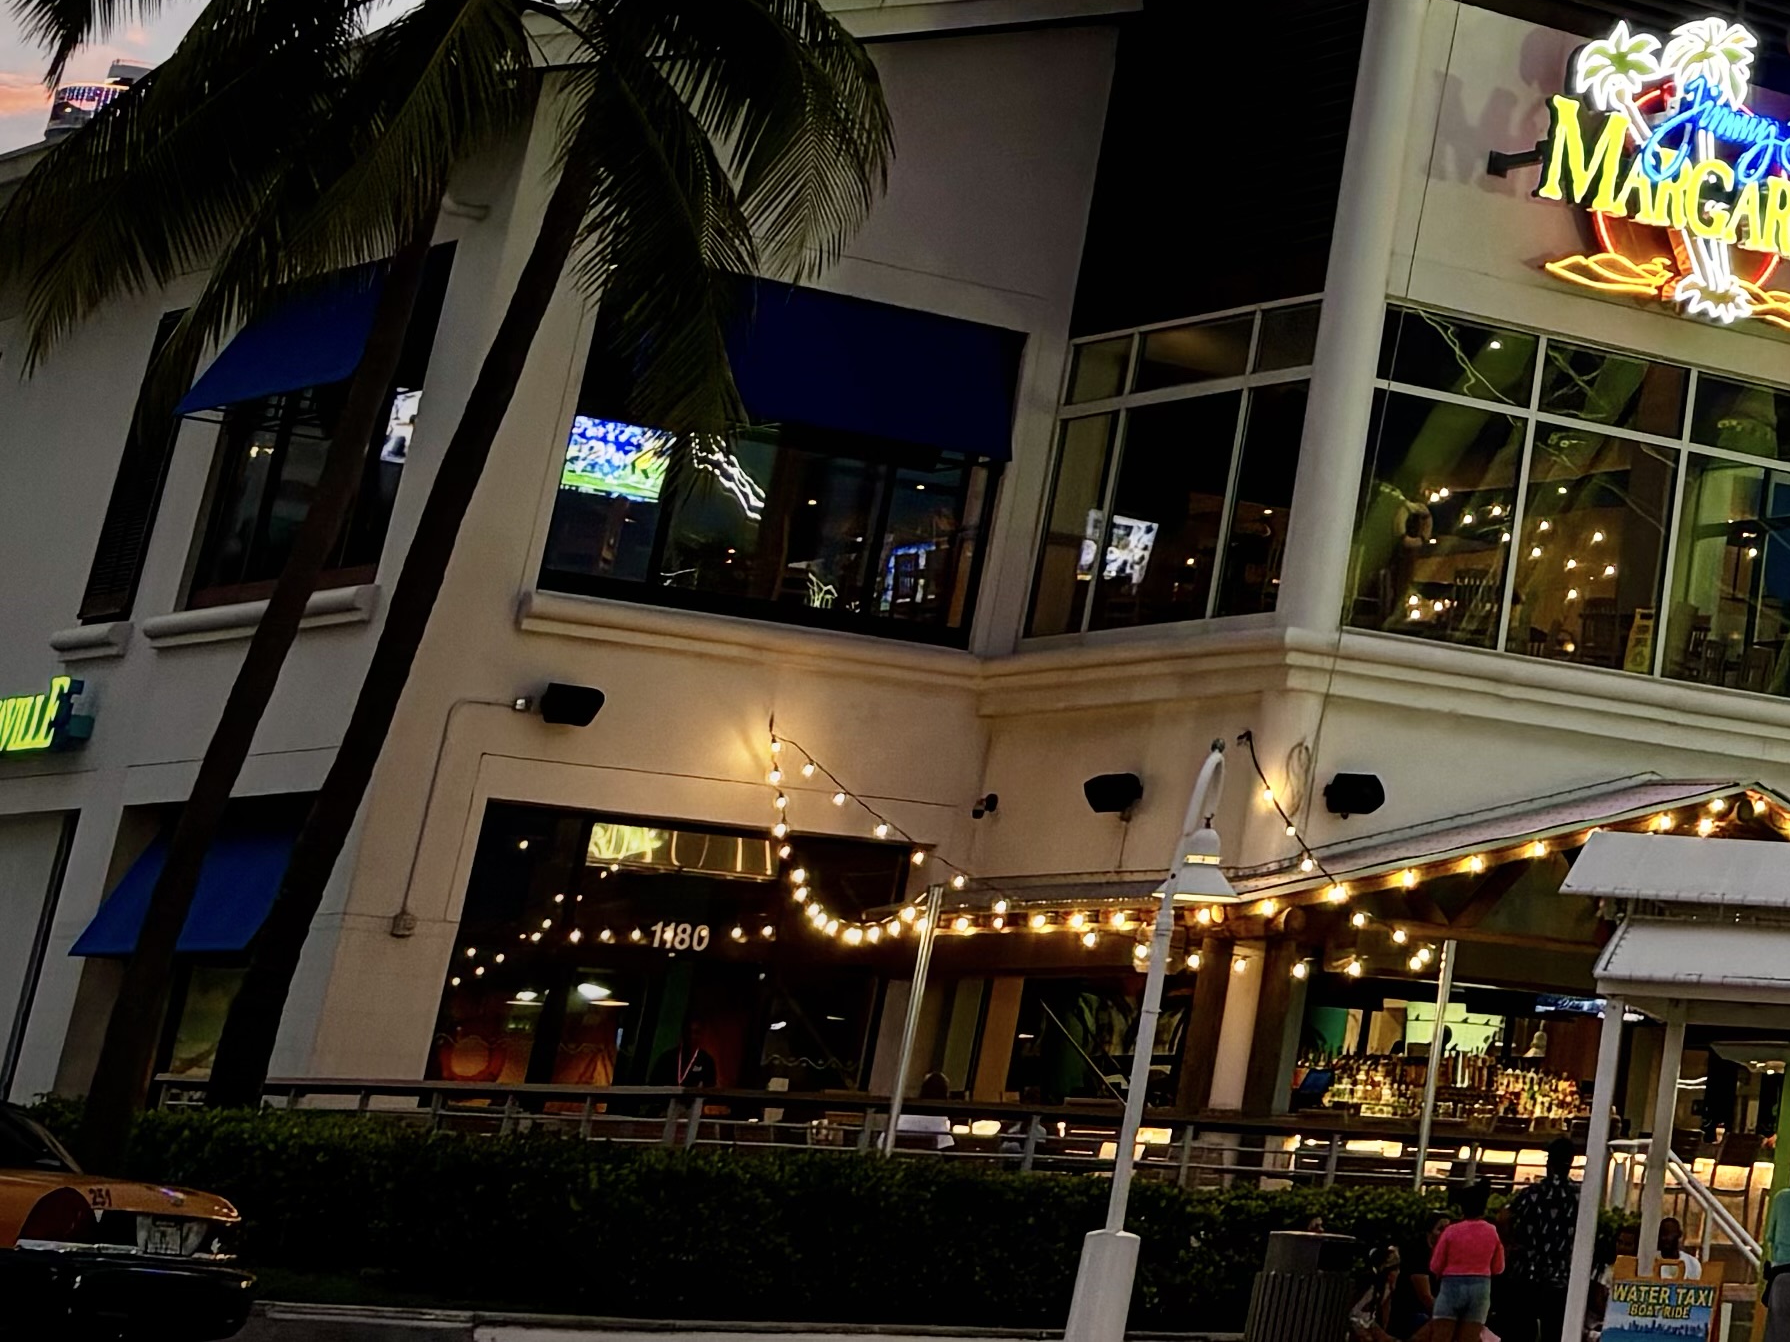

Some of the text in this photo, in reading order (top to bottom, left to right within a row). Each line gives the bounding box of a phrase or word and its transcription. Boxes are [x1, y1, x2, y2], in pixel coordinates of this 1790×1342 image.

[1641, 76, 1784, 182] Jimmy
[0, 676, 71, 751] VILLE
[651, 921, 710, 951] 1180
[1612, 1284, 1715, 1307] WATER TAXI
[1630, 1304, 1690, 1319] BOAT RIDE
